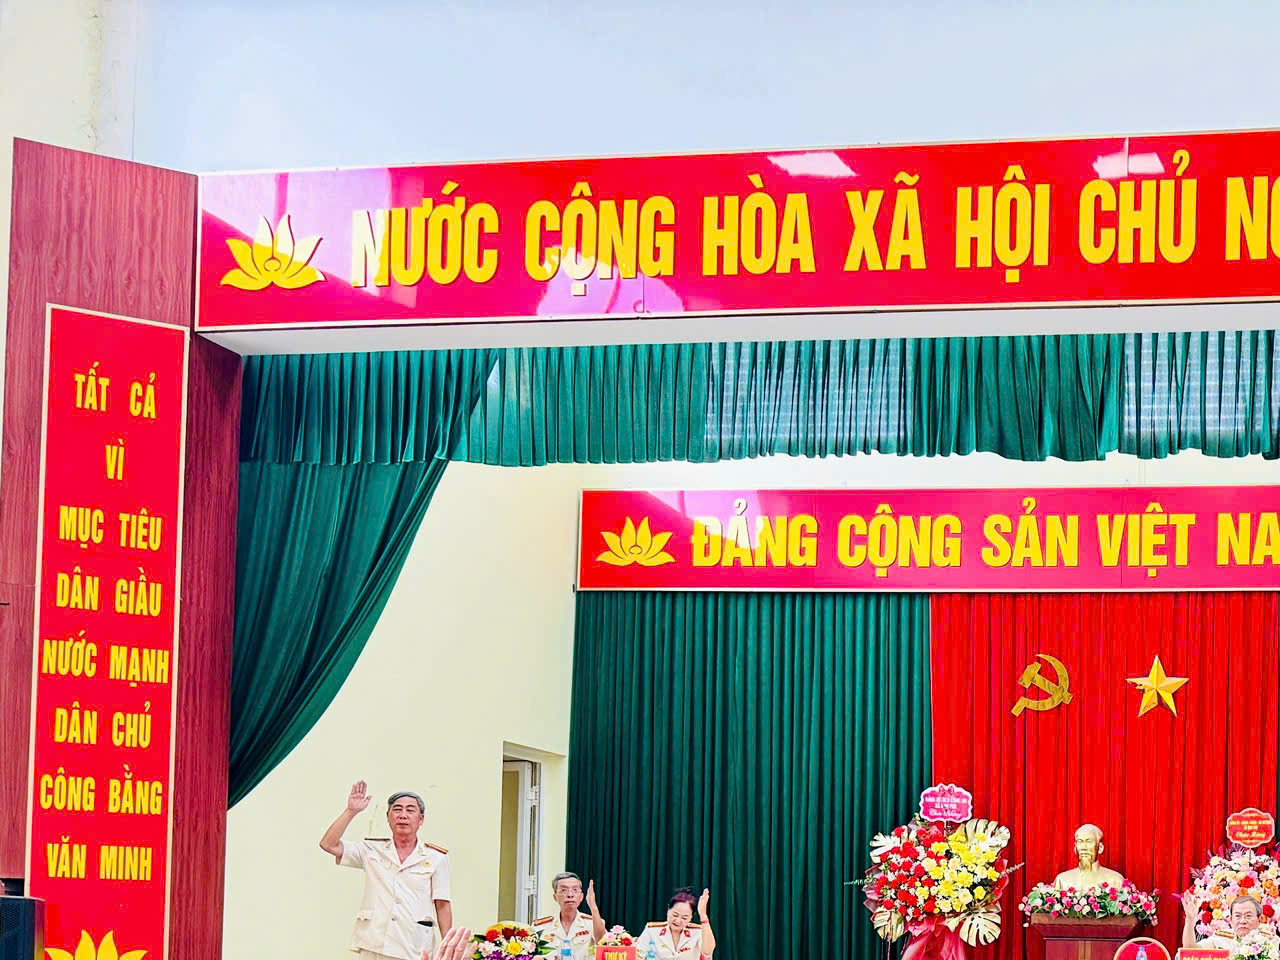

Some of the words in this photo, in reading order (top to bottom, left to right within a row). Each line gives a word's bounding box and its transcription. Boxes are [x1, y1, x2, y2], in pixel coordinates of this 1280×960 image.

[350, 180, 499, 286] NƯỚC
[525, 181, 675, 296] CỘNG
[702, 174, 816, 276] HÒA
[843, 170, 926, 272] XÃ
[955, 164, 1050, 283] HỘI
[1079, 150, 1197, 264] CHỦ
[74, 361, 110, 412] TẤT
[129, 372, 156, 419] CẢ
[105, 438, 125, 481] VÌ
[59, 505, 104, 549] MỤC
[119, 507, 162, 551] TIÊU
[690, 498, 818, 569] ĐẢNG
[837, 503, 962, 577] CỘNG
[981, 497, 1079, 567] SẢN
[1096, 502, 1196, 577] VIỆT
[56, 566, 99, 611] DÂN
[42, 630, 97, 678] NƯỚC
[109, 645, 169, 687] MẠNH
[54, 701, 98, 745] DÂN
[111, 701, 152, 748] CHỦ
[39, 767, 95, 812] CÔNG
[108, 764, 163, 816] BẰNG
[47, 835, 87, 879] VĂN
[99, 845, 153, 881] MINH
